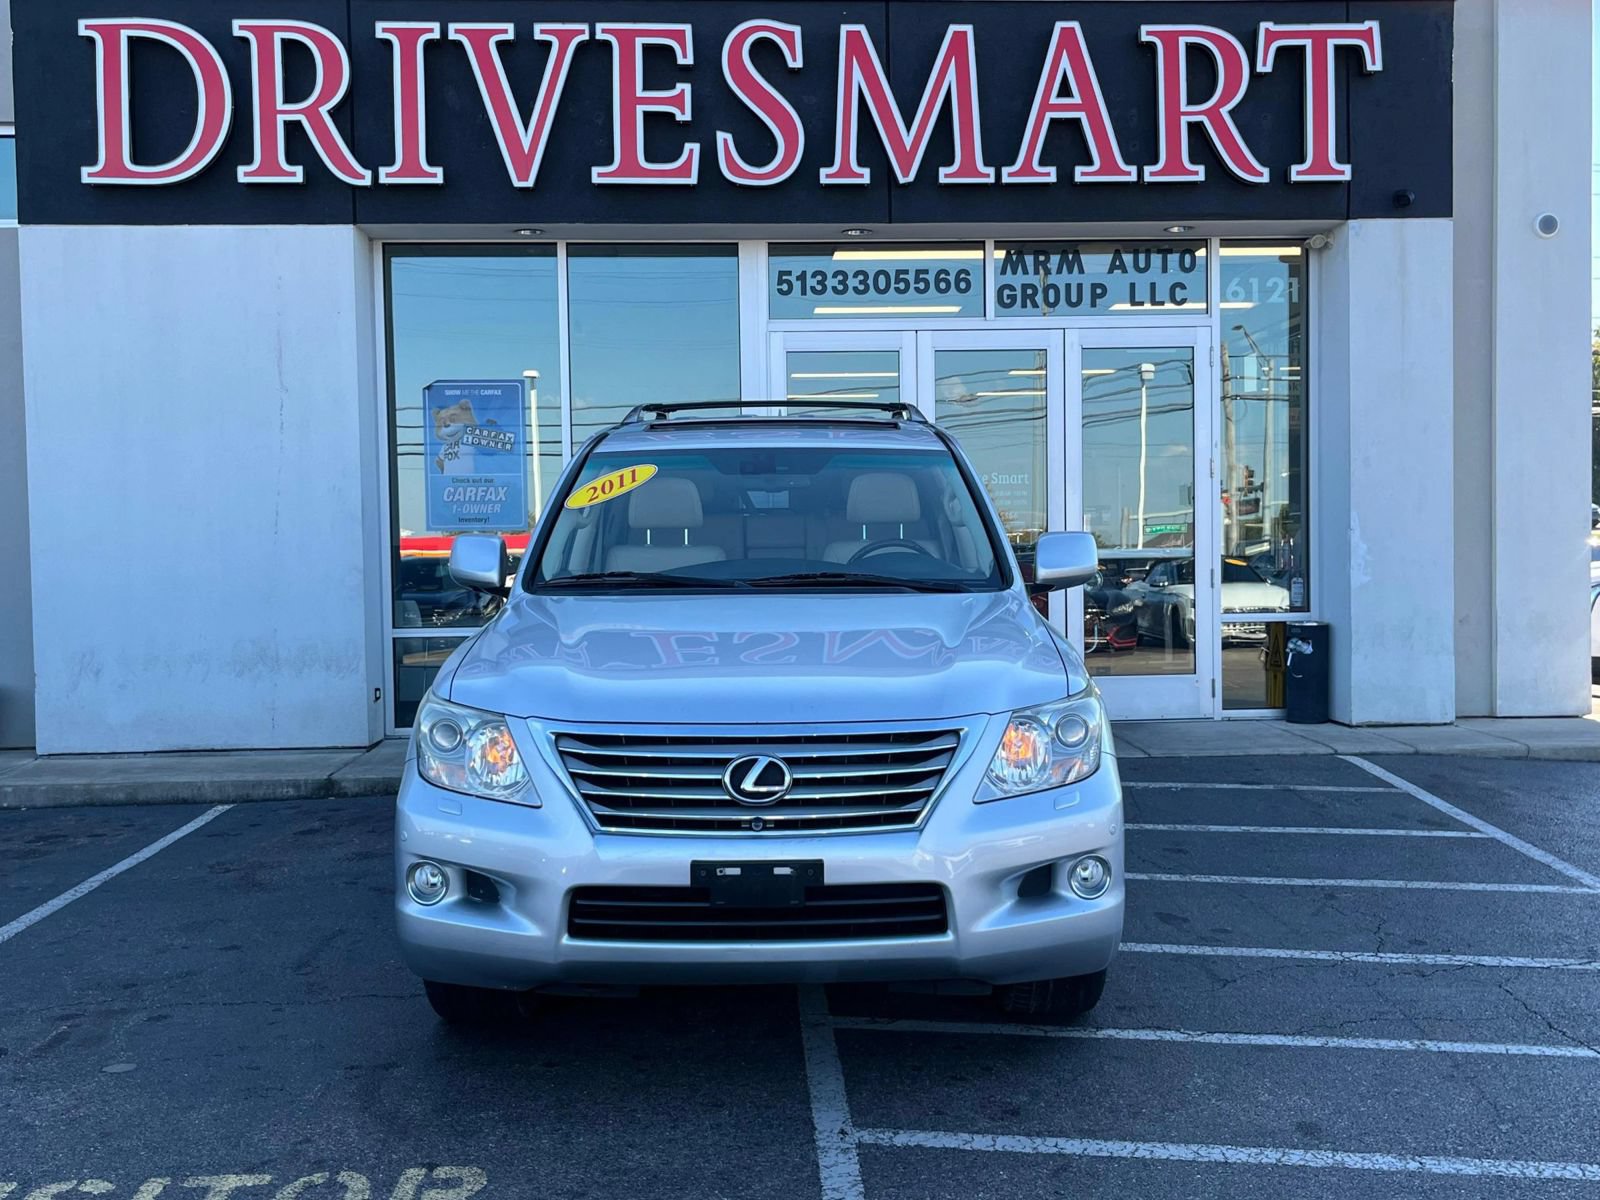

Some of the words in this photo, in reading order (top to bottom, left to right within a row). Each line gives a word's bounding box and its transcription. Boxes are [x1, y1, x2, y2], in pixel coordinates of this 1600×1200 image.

[78, 17, 1383, 188] DRIVESMART
[1000, 249, 1085, 275] MRM
[1107, 249, 1197, 275] AUTO
[776, 268, 971, 297] 5133305566
[996, 282, 1108, 309] GROUP
[1129, 281, 1188, 307] LLC
[1225, 277, 1299, 303] 6121
[466, 427, 514, 442] CARFAX
[586, 468, 638, 503] 2011
[991, 472, 1029, 485] Smart
[443, 486, 508, 502] CARFAX
[452, 503, 501, 514] 1-OWNER
[458, 516, 490, 524] Inventory!
